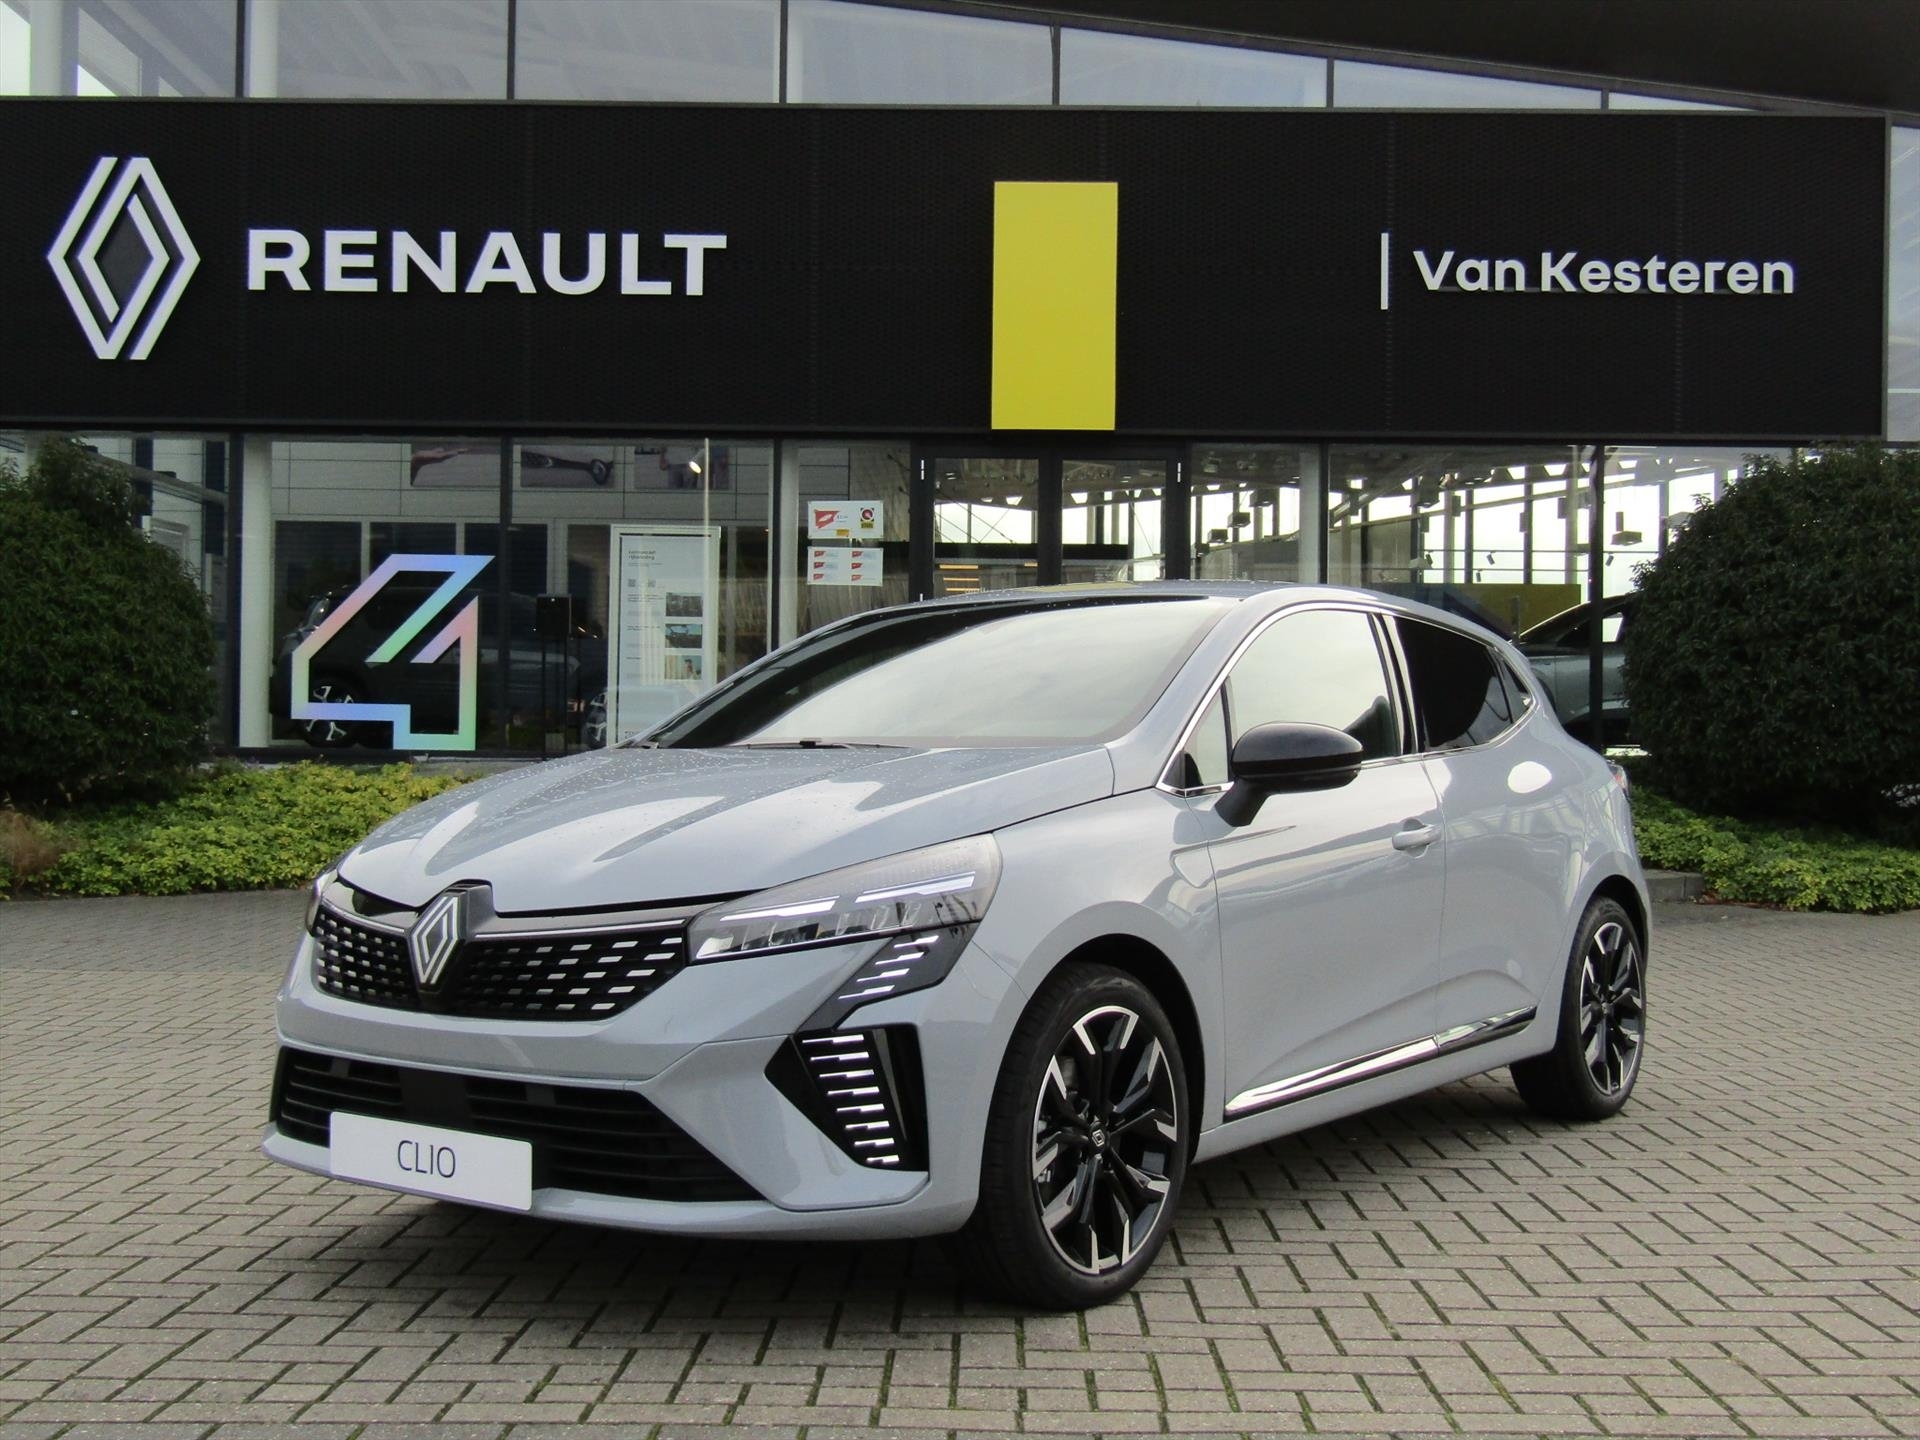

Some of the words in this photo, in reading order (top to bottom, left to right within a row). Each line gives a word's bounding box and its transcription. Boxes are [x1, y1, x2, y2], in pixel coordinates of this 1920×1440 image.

[247, 229, 728, 296] RENAULT
[1412, 250, 1526, 292] Van
[1541, 252, 1794, 294] Kesteren
[397, 1139, 456, 1179] CLIO
